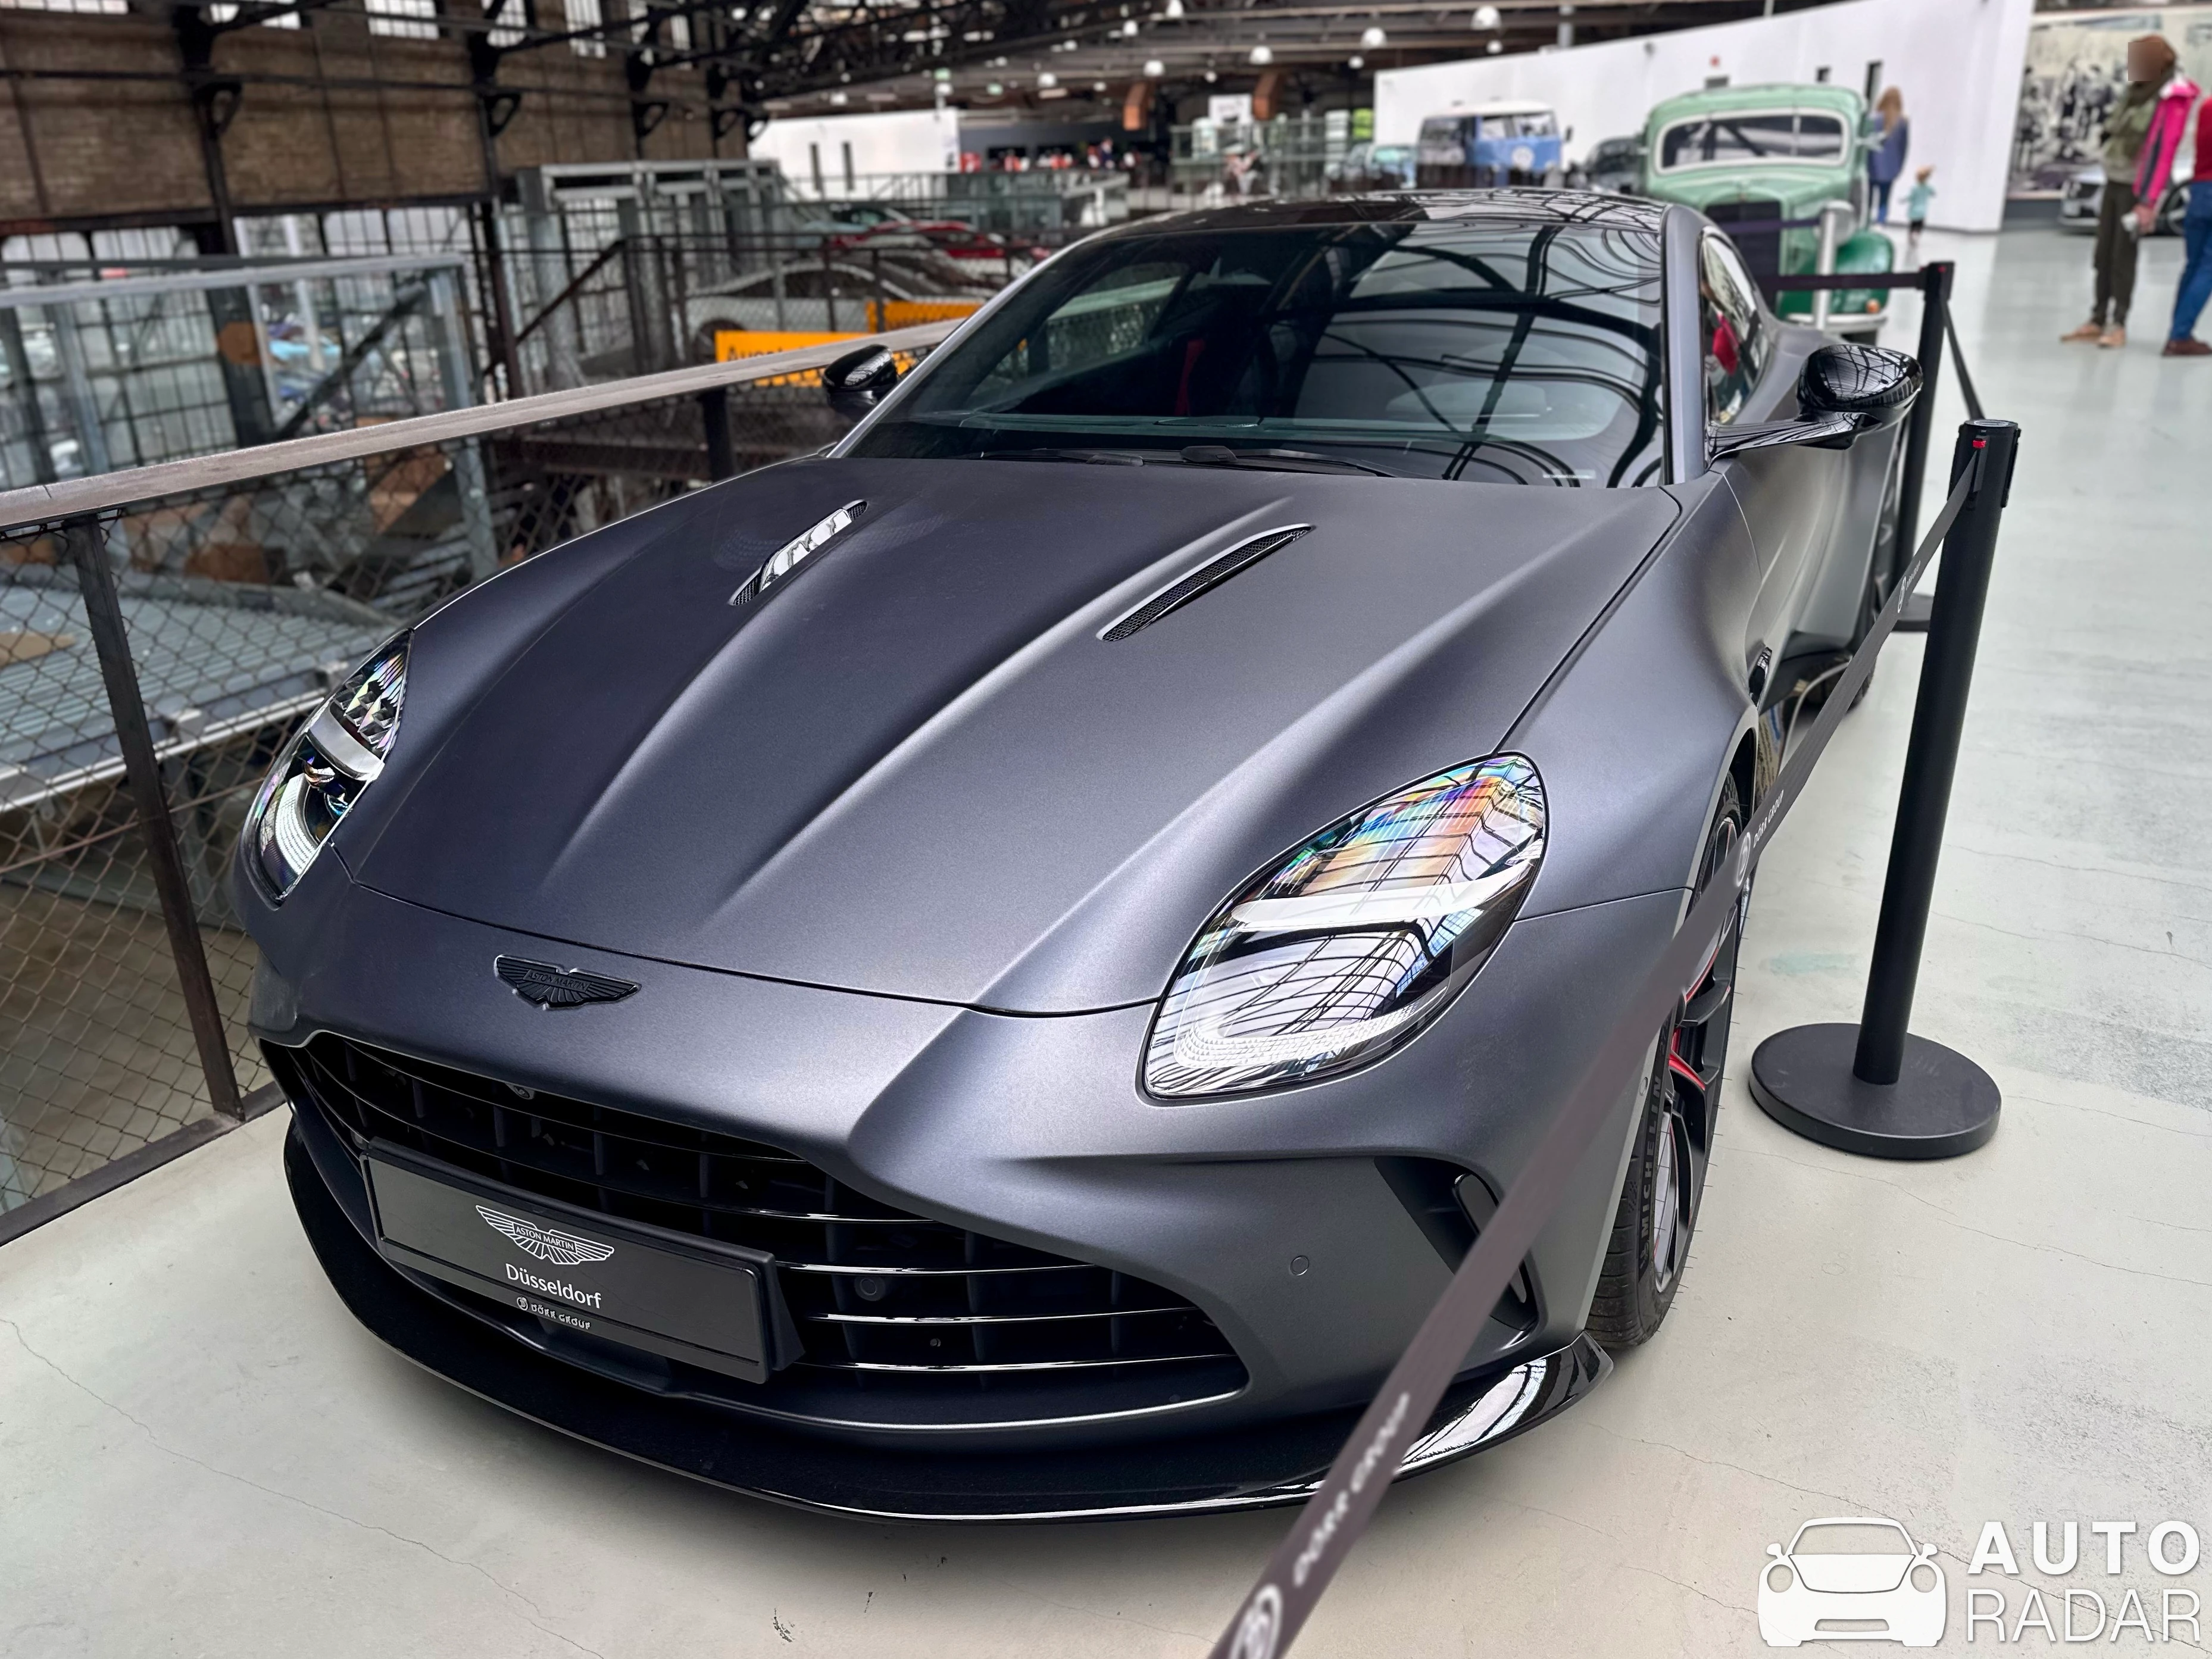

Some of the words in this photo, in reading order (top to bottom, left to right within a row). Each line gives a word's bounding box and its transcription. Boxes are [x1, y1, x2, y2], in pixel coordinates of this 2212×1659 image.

[529, 971, 552, 983] ASTON
[555, 979, 587, 990] MARTIN
[1641, 1076, 1661, 1238] MICHELIN
[516, 1226, 541, 1241] ASTON
[543, 1235, 574, 1251] MARTIN
[506, 1263, 601, 1309] Düsseldorf
[559, 1314, 591, 1330] GROUP
